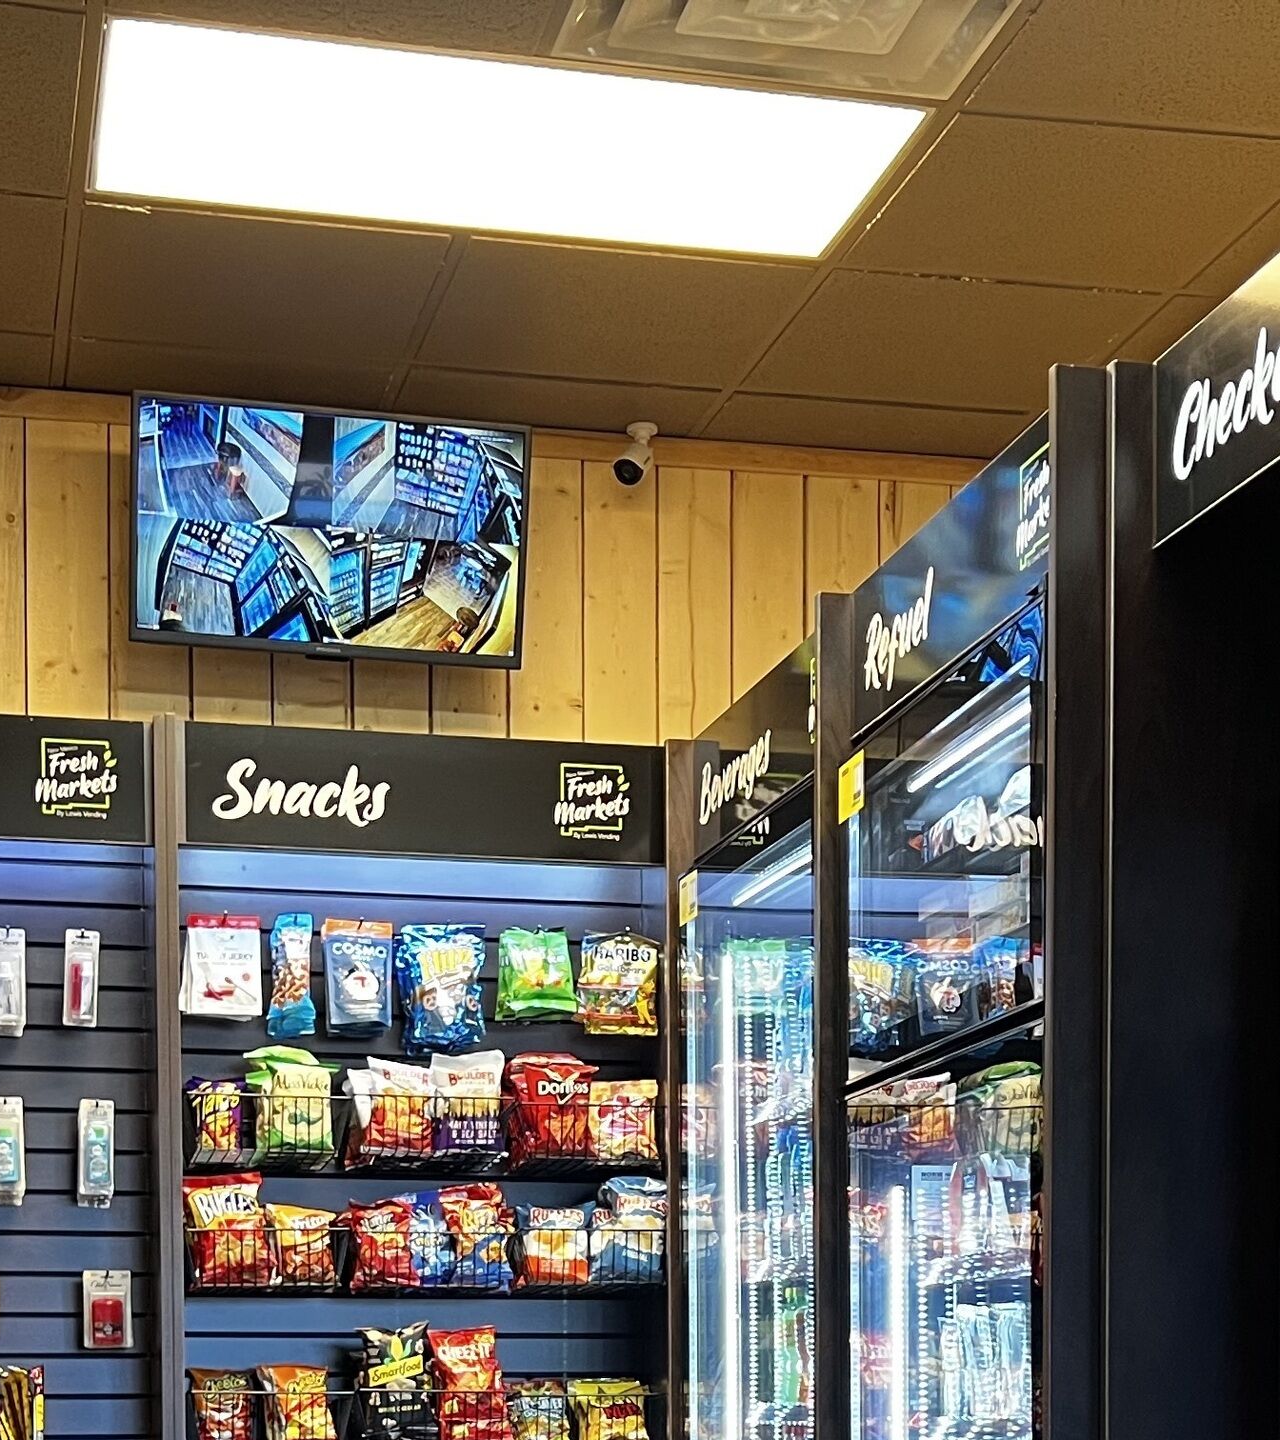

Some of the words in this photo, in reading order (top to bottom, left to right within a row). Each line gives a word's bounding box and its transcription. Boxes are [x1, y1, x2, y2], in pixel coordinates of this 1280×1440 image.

[864, 565, 935, 692] Refuel
[48, 749, 99, 778] Fresh
[699, 728, 770, 826] Beverages
[35, 768, 118, 803] Markets
[211, 757, 391, 828] Snacks
[566, 774, 613, 801] Fresh
[554, 792, 630, 826] Markets
[331, 942, 388, 960] COSMO
[593, 945, 651, 963] HARIBO
[448, 1070, 496, 1087] BOULDER
[537, 1079, 589, 1096] Doritos
[193, 1191, 259, 1227] BUGLES
[531, 1208, 584, 1224] RULES
[371, 1360, 422, 1382] Smartfood
